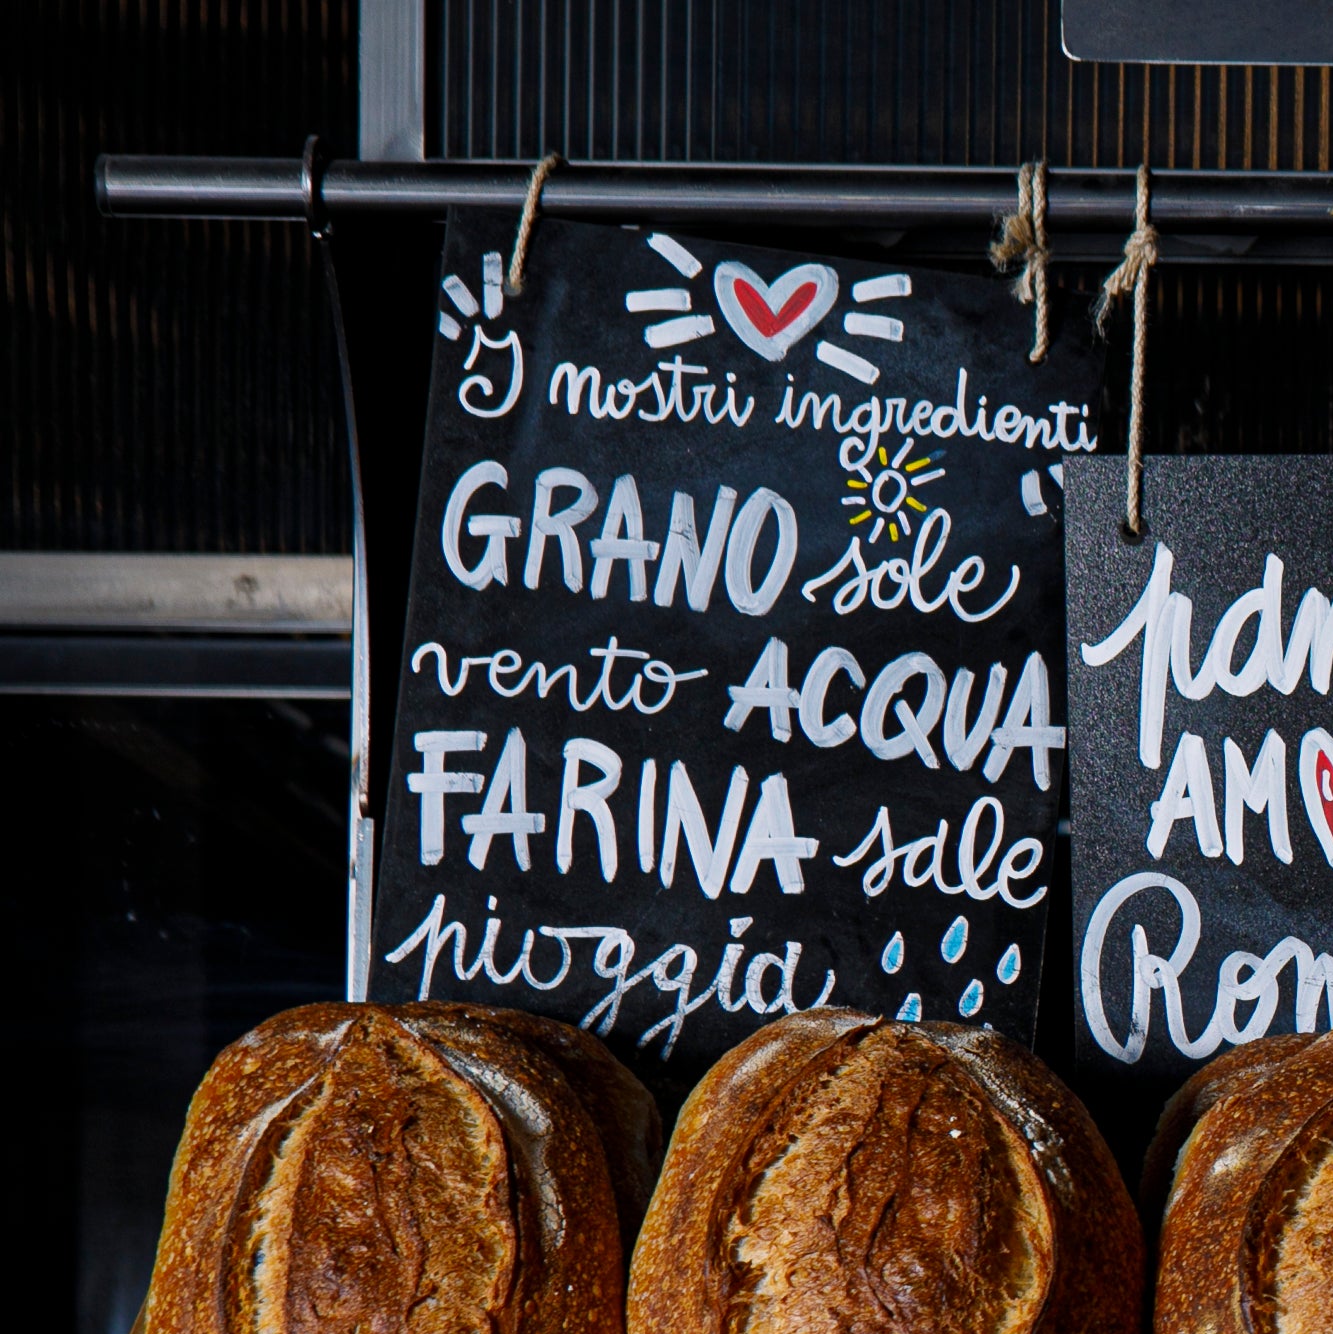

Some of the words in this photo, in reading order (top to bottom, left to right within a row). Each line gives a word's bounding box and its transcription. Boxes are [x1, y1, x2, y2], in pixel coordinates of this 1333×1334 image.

[549, 355, 755, 426] nostri
[774, 367, 1098, 472] ingredienti
[442, 460, 798, 616] GRANO
[801, 508, 1020, 624] sole
[411, 636, 708, 714] vento
[723, 636, 1066, 791] ACQUA
[407, 727, 820, 899] FARINA
[832, 796, 1047, 909] sale
[385, 894, 836, 1062] pioggia
